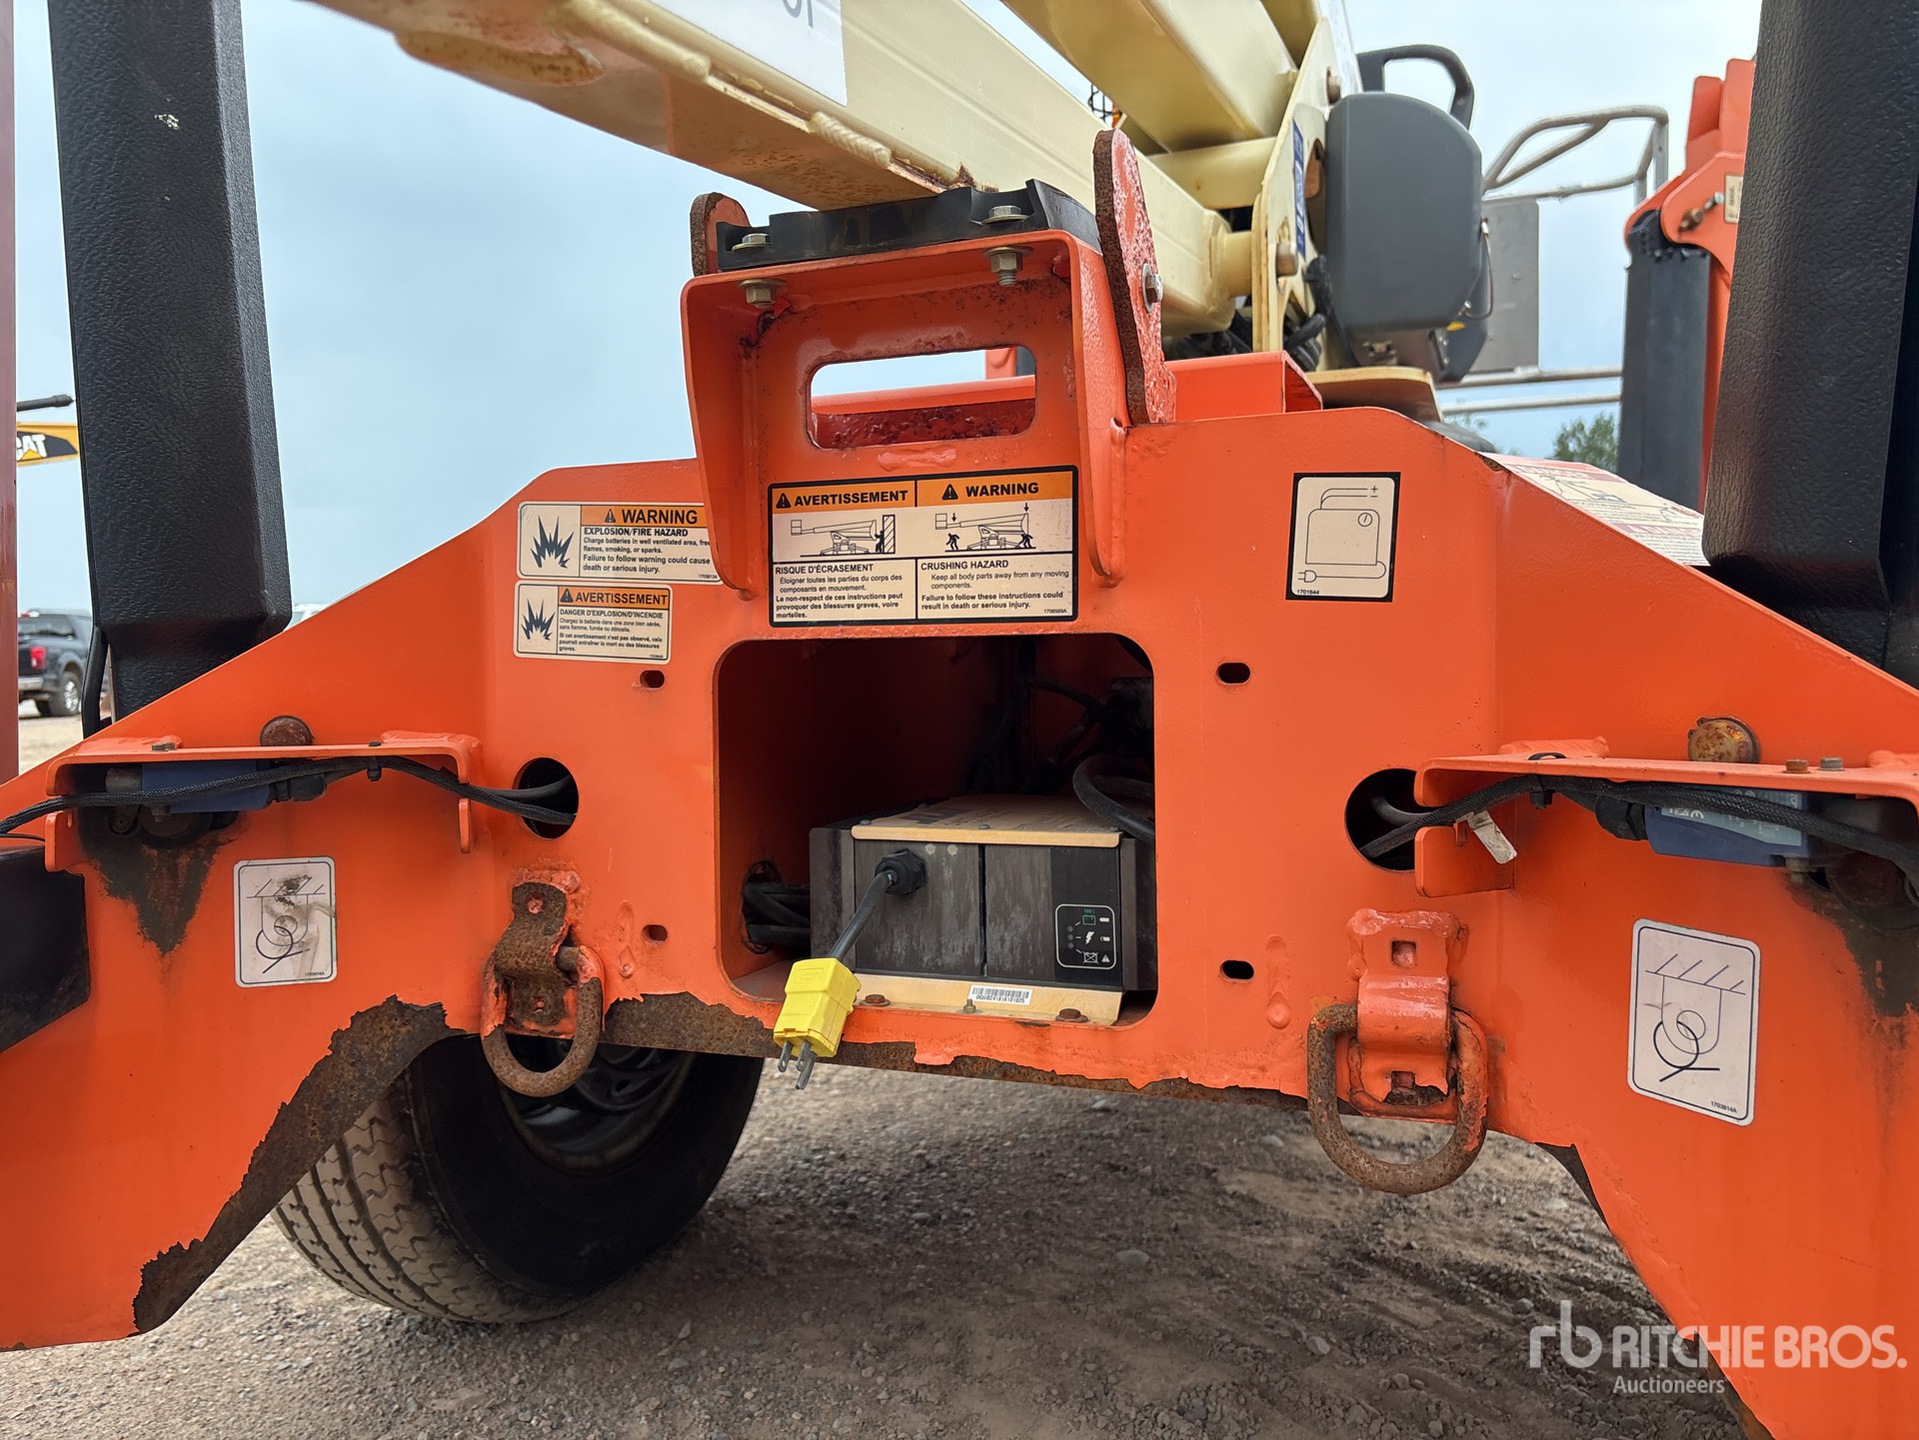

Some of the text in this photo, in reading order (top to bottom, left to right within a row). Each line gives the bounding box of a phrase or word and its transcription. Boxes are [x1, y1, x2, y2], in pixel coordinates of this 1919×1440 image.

[966, 482, 1040, 498] WARNING
[794, 490, 908, 506] AVERTISSEMENT
[622, 509, 698, 524] WARNING
[584, 528, 688, 537] EXPLOSION/FIRE HAZARD
[638, 556, 666, 564] warning
[920, 560, 1008, 570] CRUSHING HAZARD
[583, 564, 602, 572] death
[639, 565, 660, 574] injury.
[776, 564, 874, 574] RISQUE D'ÉCRASEMENT
[780, 577, 805, 585] Éloigner
[838, 576, 860, 584] parties
[959, 573, 974, 581] body
[1044, 570, 1069, 578] moving
[932, 582, 972, 590] components.
[576, 592, 668, 605] AVERTISSEMENT
[888, 592, 903, 600] peut
[1009, 601, 1031, 610] injury.
